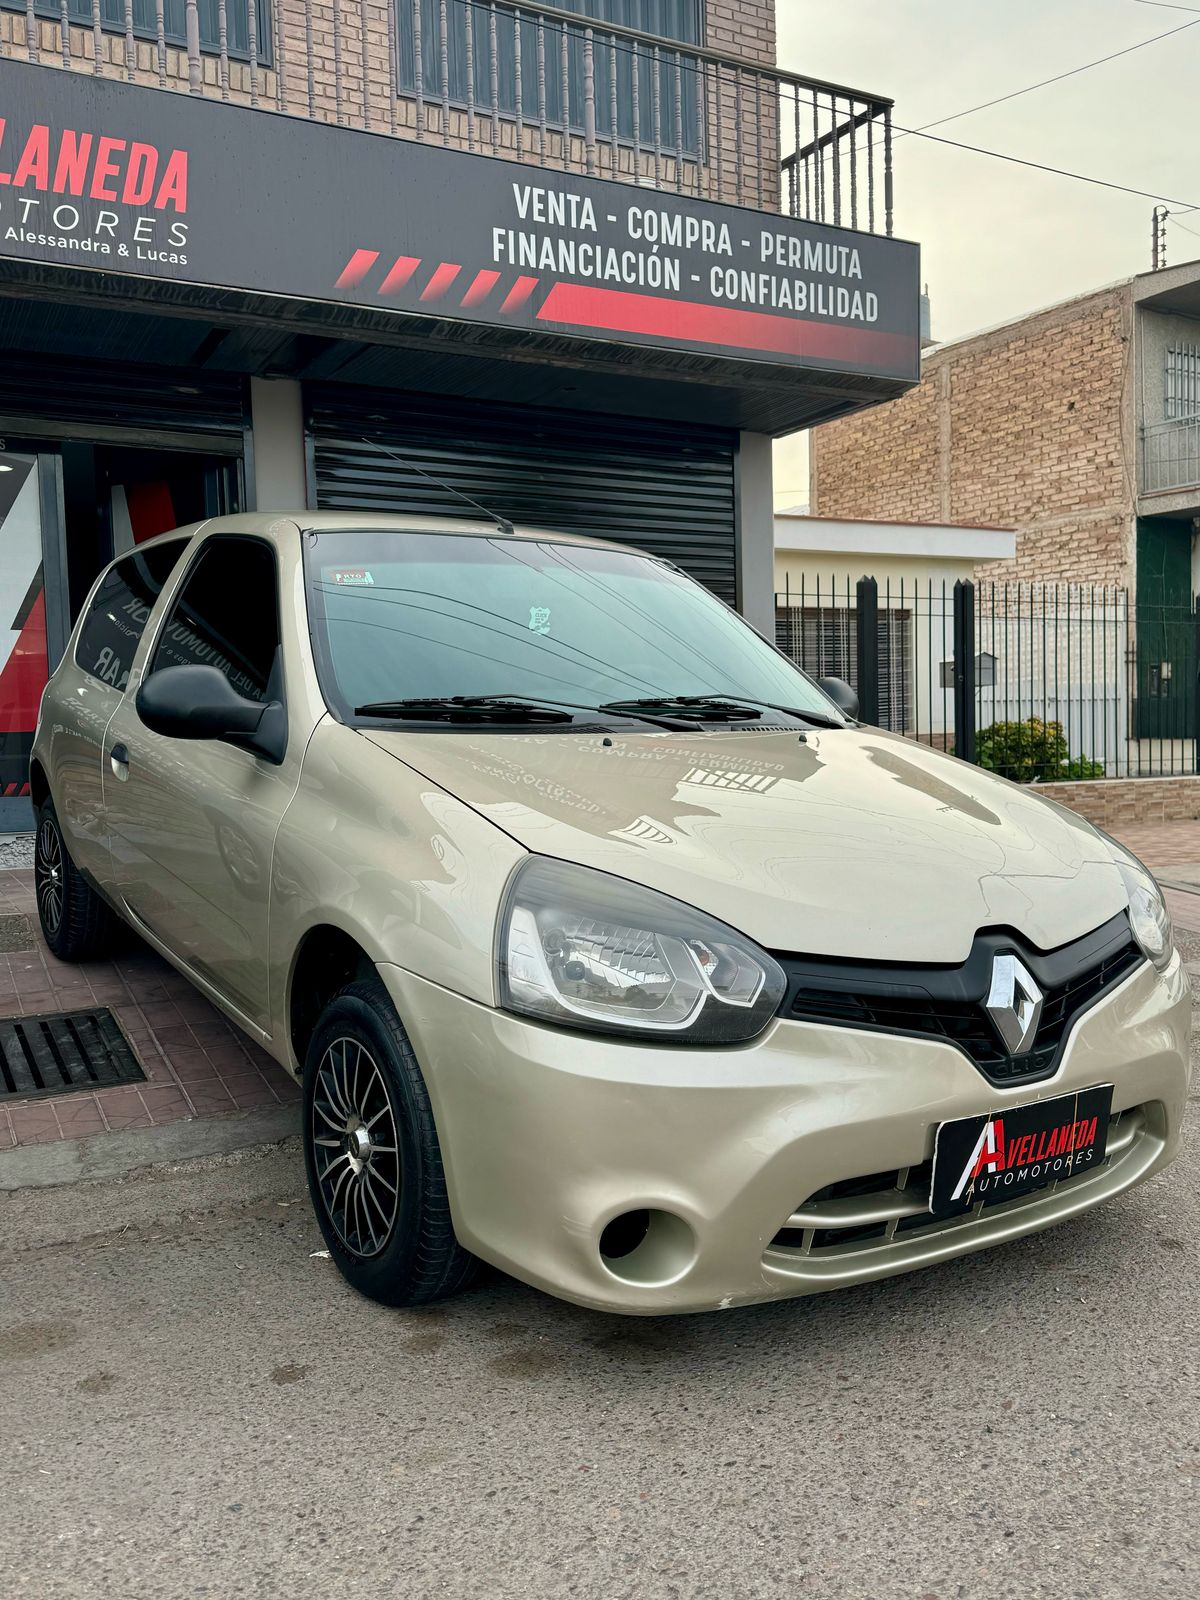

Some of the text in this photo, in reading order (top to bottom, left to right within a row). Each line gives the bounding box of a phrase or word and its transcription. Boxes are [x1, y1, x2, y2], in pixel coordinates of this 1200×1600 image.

[0, 117, 188, 213] ANEDA
[0, 198, 189, 247] TORES
[5, 226, 188, 265] Alessandra & Lucas
[512, 183, 598, 232] VENTA
[627, 206, 733, 257] COMPRA
[760, 231, 863, 280] PERMUTA
[492, 227, 681, 291] FINANCIACIÓN
[709, 265, 879, 323] CONFIABILIDAD
[950, 1116, 1099, 1201] AVELLANEDA
[965, 1148, 1093, 1194] AUTOMOTORES
